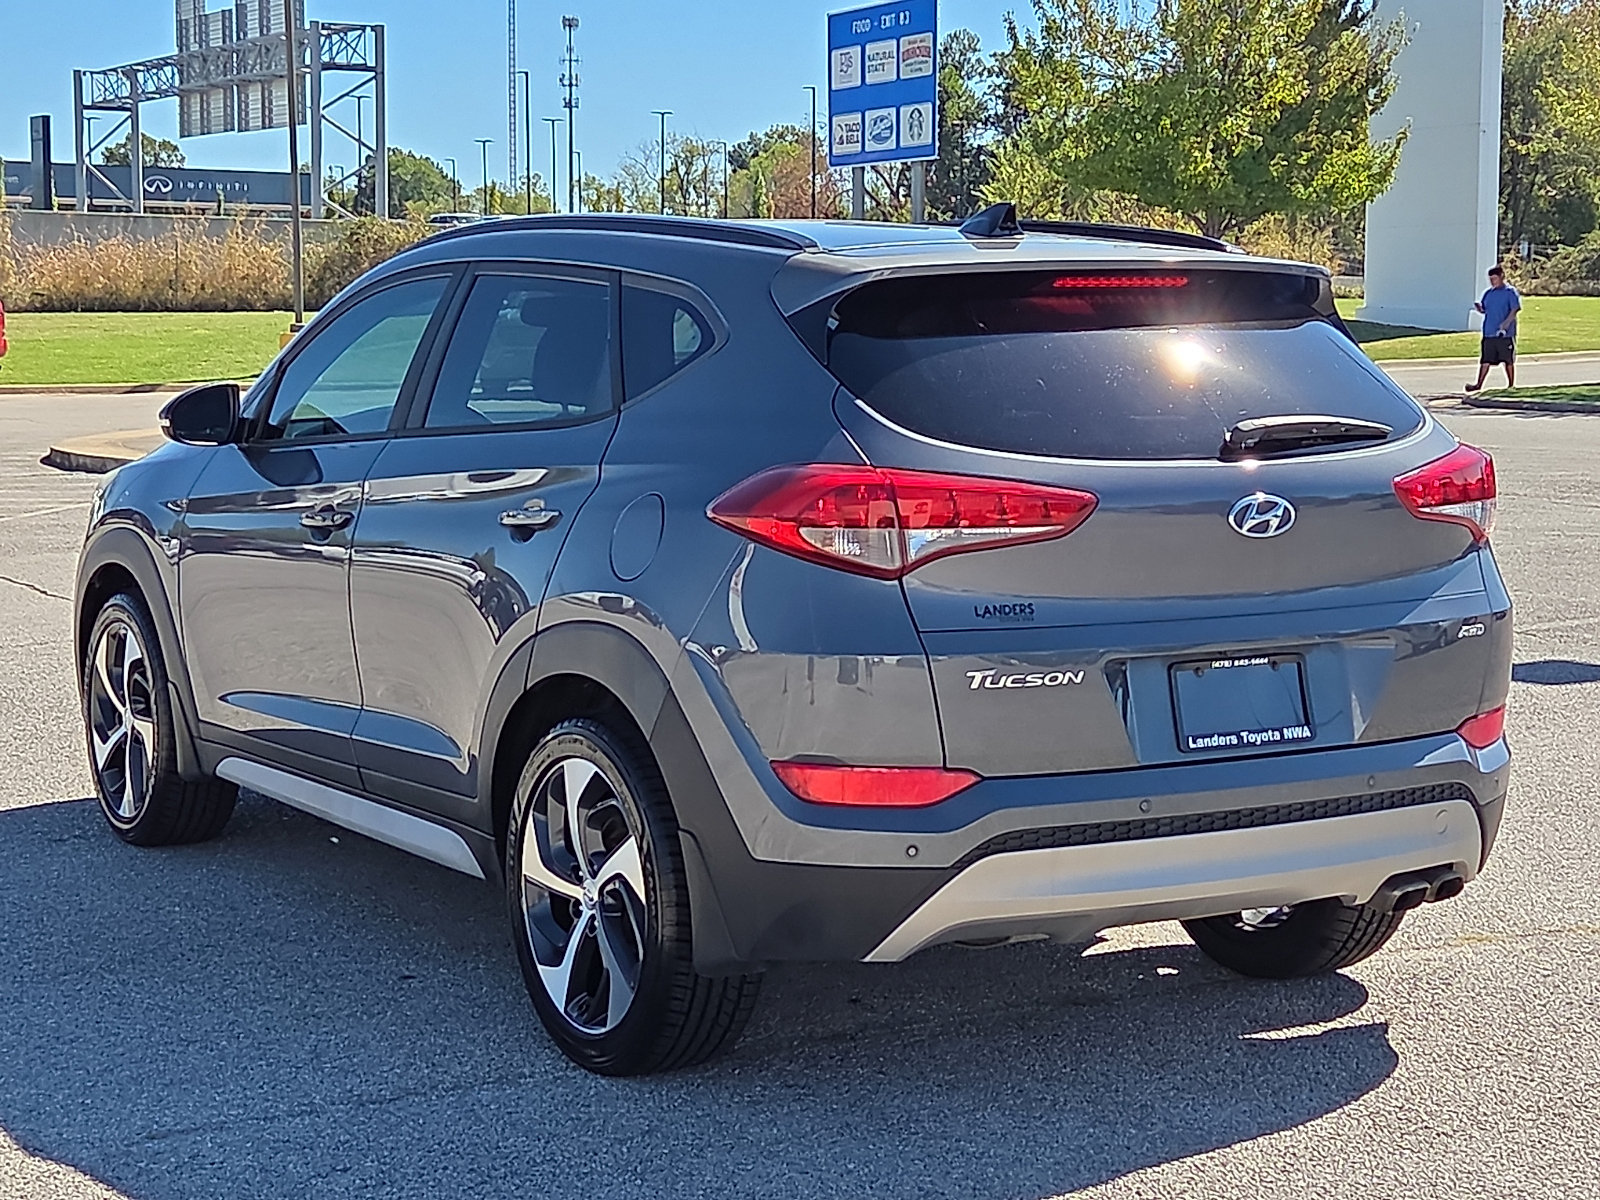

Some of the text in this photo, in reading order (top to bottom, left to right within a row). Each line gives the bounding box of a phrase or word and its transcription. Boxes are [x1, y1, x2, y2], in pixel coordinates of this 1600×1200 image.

[852, 18, 871, 34] FOOD
[880, 13, 896, 29] EXIT
[867, 50, 896, 63] NATURAL
[867, 62, 886, 74] STATE
[844, 121, 861, 134] TACO
[845, 134, 860, 146] BELL
[179, 180, 248, 192] INFINITI
[974, 603, 1035, 619] LANDERS
[965, 668, 1085, 690] TUCSON
[1188, 725, 1312, 749] Landers Toyota NWA
